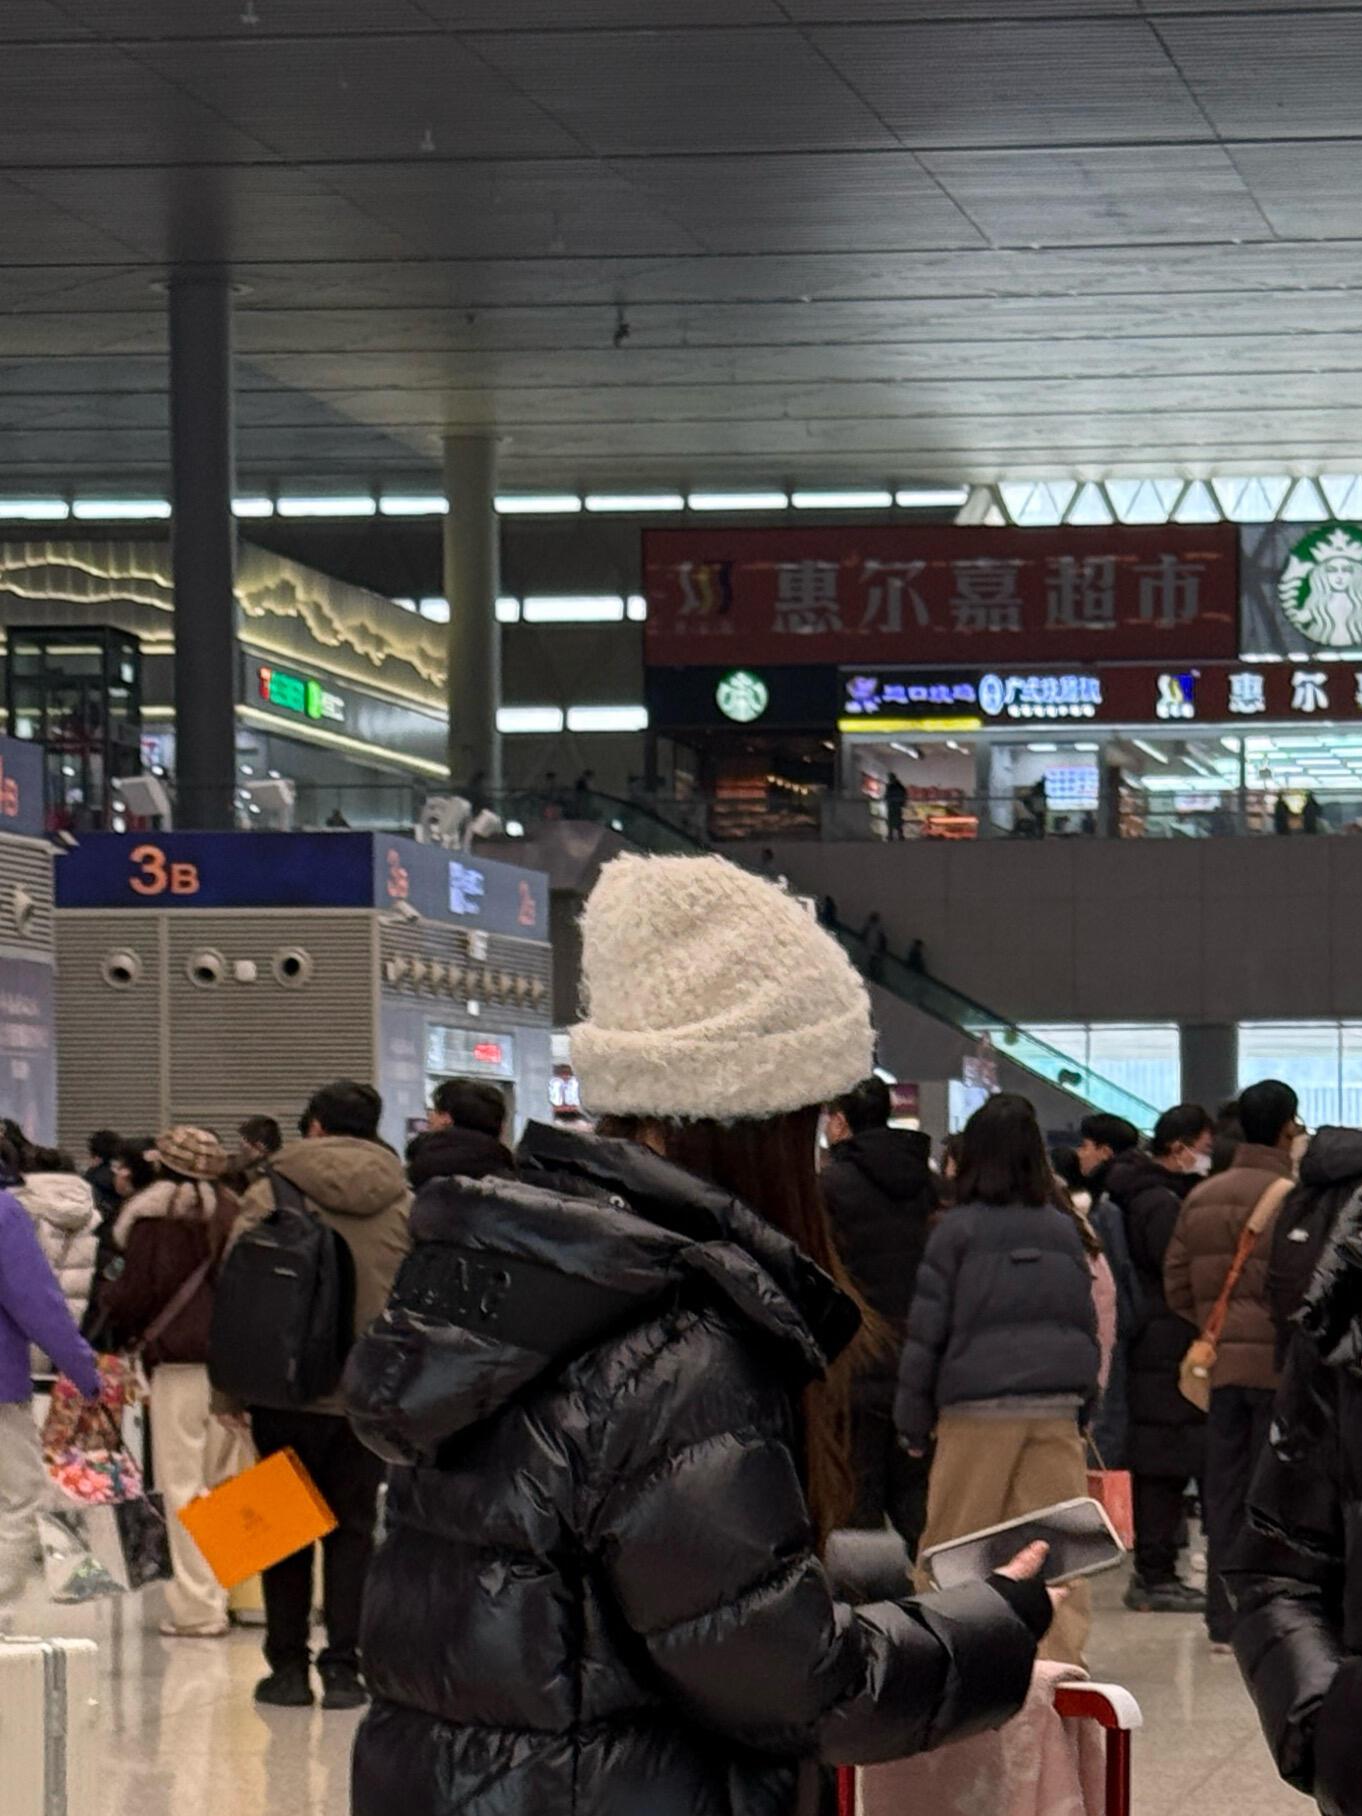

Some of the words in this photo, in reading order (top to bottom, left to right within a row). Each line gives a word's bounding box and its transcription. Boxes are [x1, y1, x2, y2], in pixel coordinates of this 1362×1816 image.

[773, 554, 1207, 634] 惠尔嘉超市
[128, 843, 201, 897] 3B
